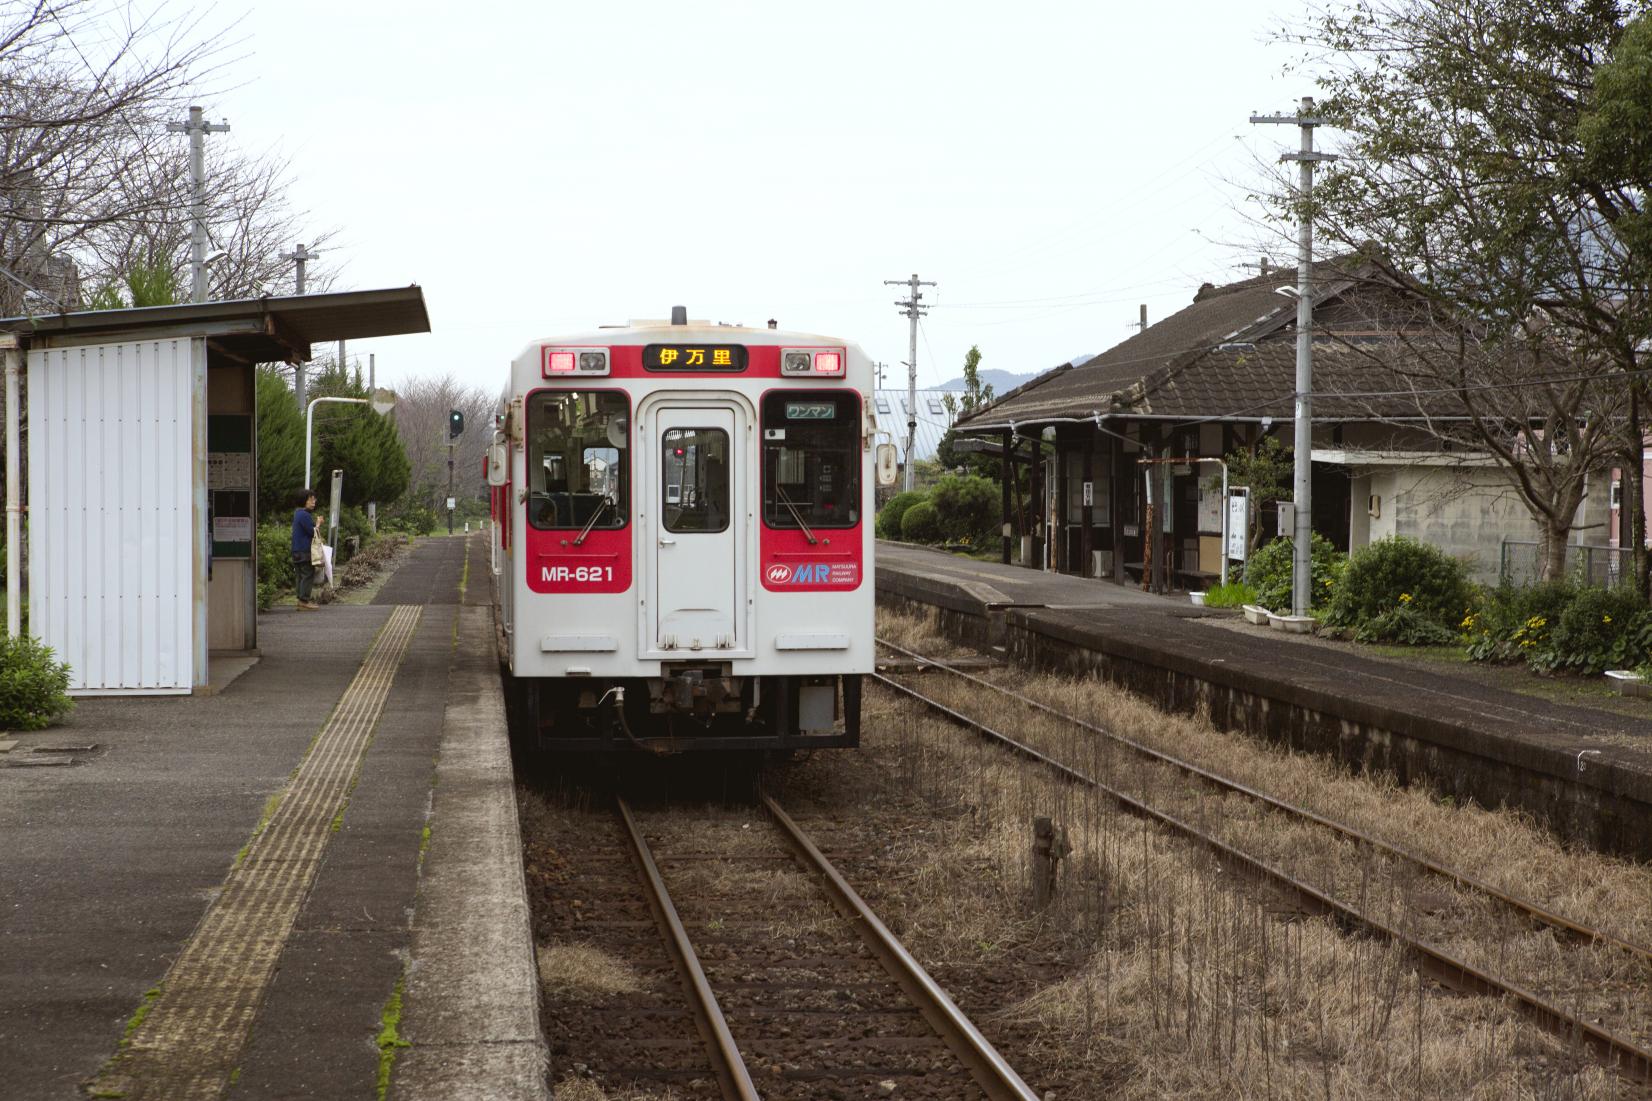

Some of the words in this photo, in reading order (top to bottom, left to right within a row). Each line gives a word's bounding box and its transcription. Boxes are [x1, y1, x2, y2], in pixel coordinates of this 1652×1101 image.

[659, 348, 732, 365] 伊万里
[789, 406, 832, 417] ワンマン
[541, 566, 613, 582] MR-621
[791, 564, 830, 583] MR
